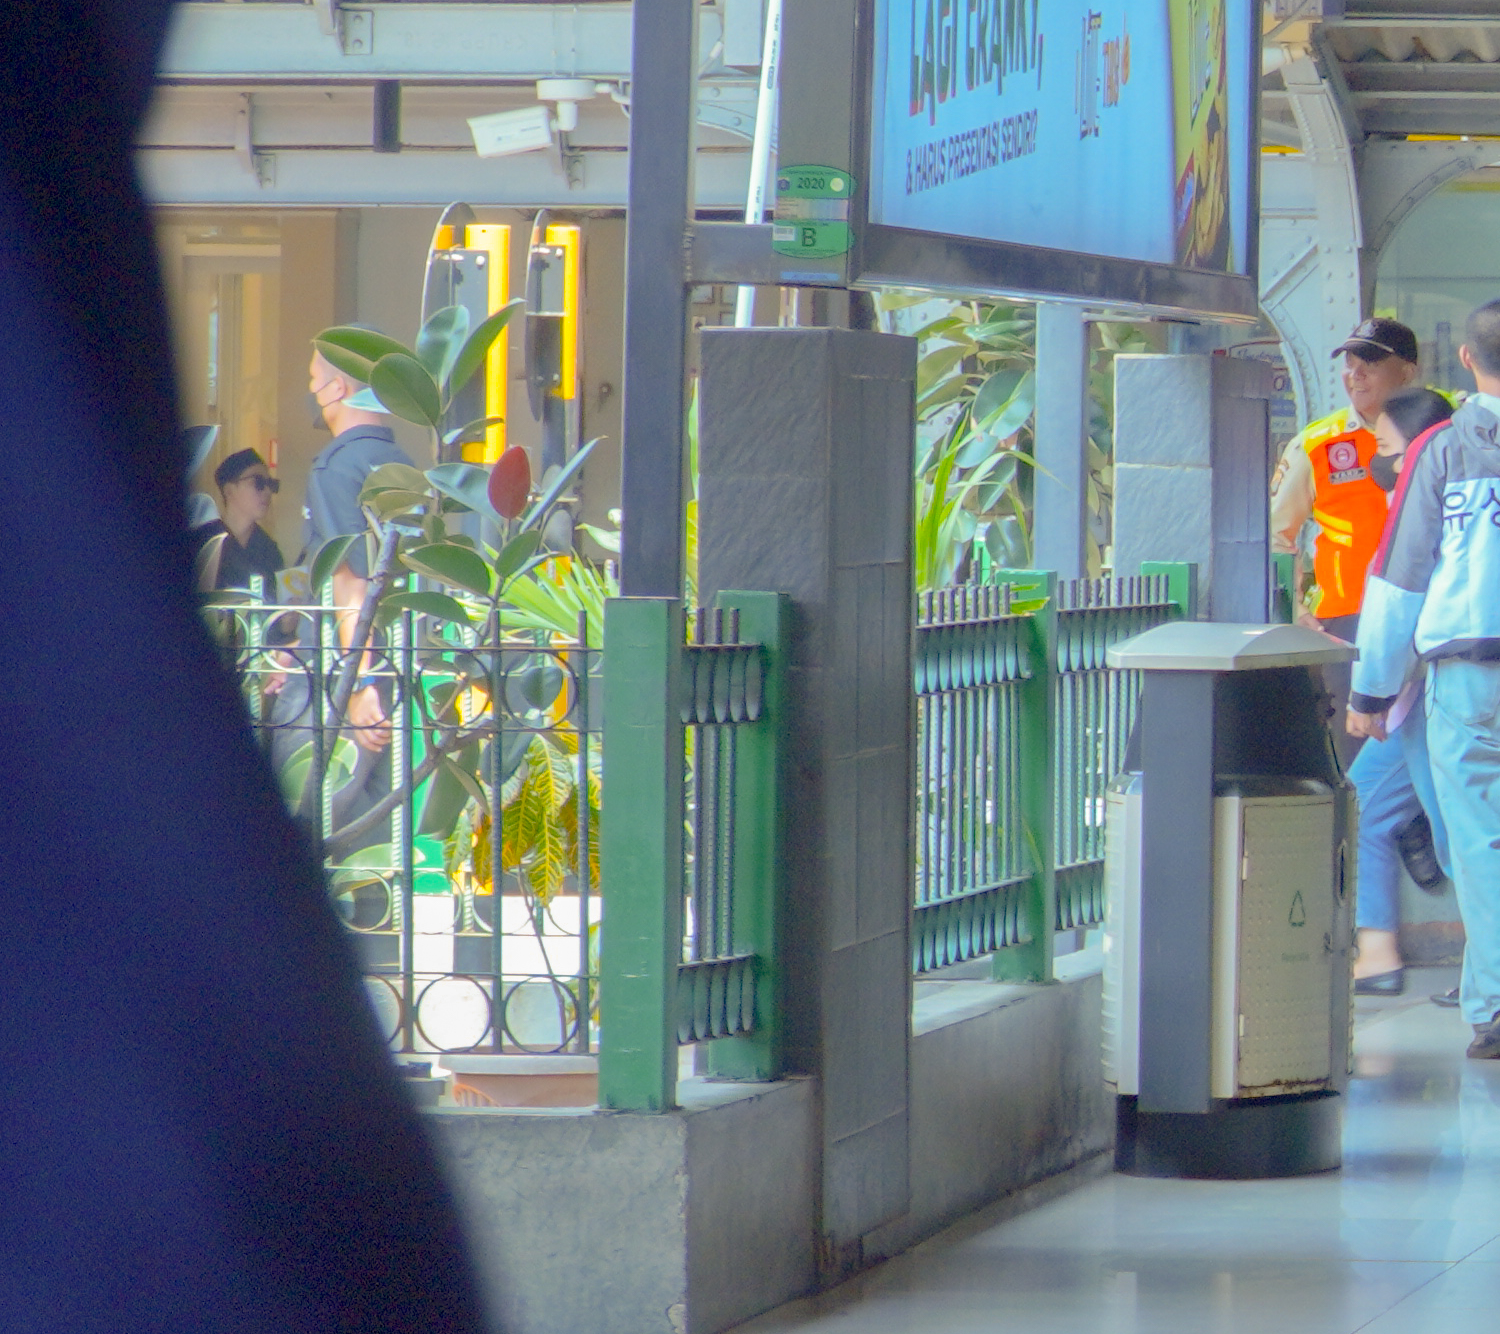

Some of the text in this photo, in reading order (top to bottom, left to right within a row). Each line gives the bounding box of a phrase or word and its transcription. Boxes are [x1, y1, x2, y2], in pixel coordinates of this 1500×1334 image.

[915, 138, 946, 194] HARUS
[947, 120, 999, 183] PRESENTASI
[797, 177, 825, 190] 2020
[801, 227, 817, 247] B
